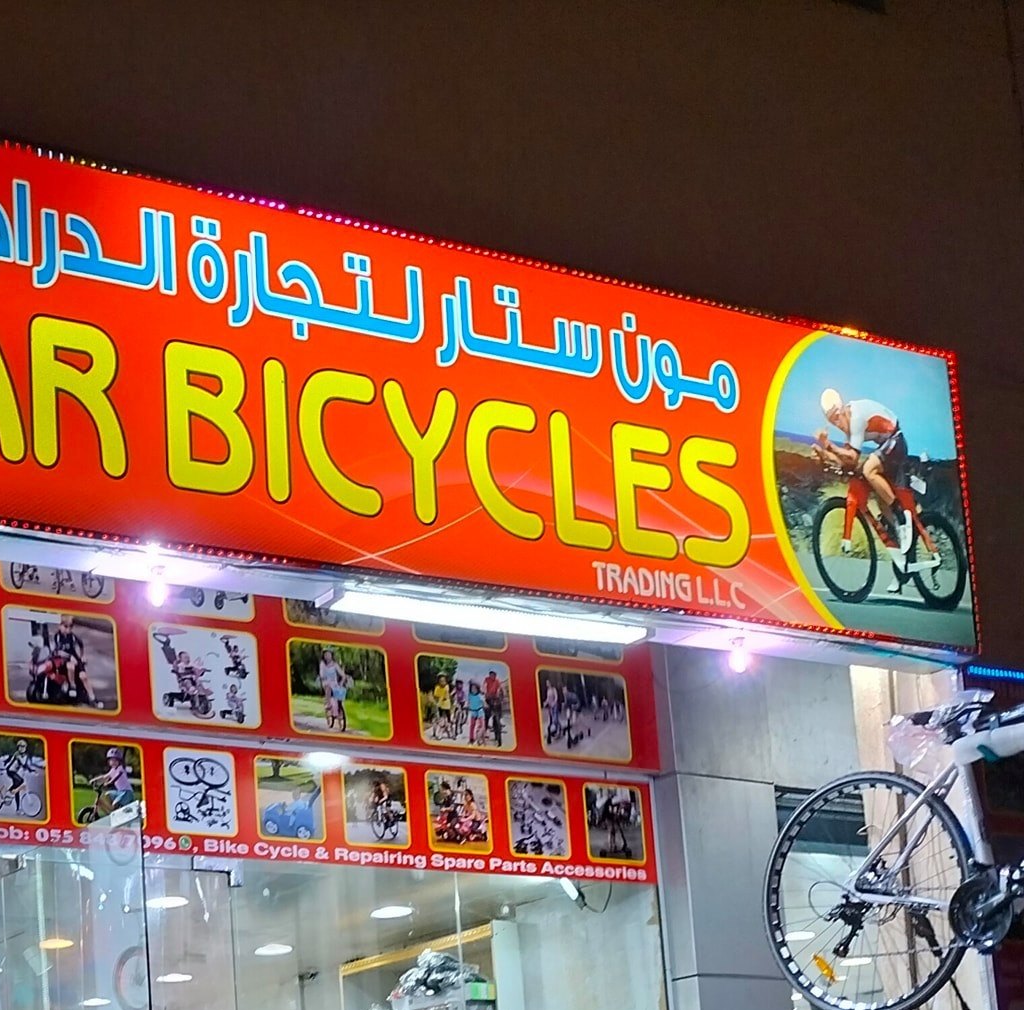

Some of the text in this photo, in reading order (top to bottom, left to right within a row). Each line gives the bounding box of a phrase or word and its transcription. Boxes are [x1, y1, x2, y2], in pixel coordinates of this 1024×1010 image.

[187, 215, 424, 344] لتجارة
[436, 275, 603, 379] ستار
[610, 312, 740, 412] مون
[163, 338, 752, 569] BICYCLES
[592, 561, 692, 603] TRADING
[35, 828, 74, 844] 055
[204, 838, 249, 855] Bike
[253, 842, 311, 860] Cycle
[314, 847, 331, 860] &
[334, 847, 427, 869] Repairing
[430, 853, 486, 873] Spare
[489, 857, 538, 875] Parts
[540, 863, 648, 882] Accessories
